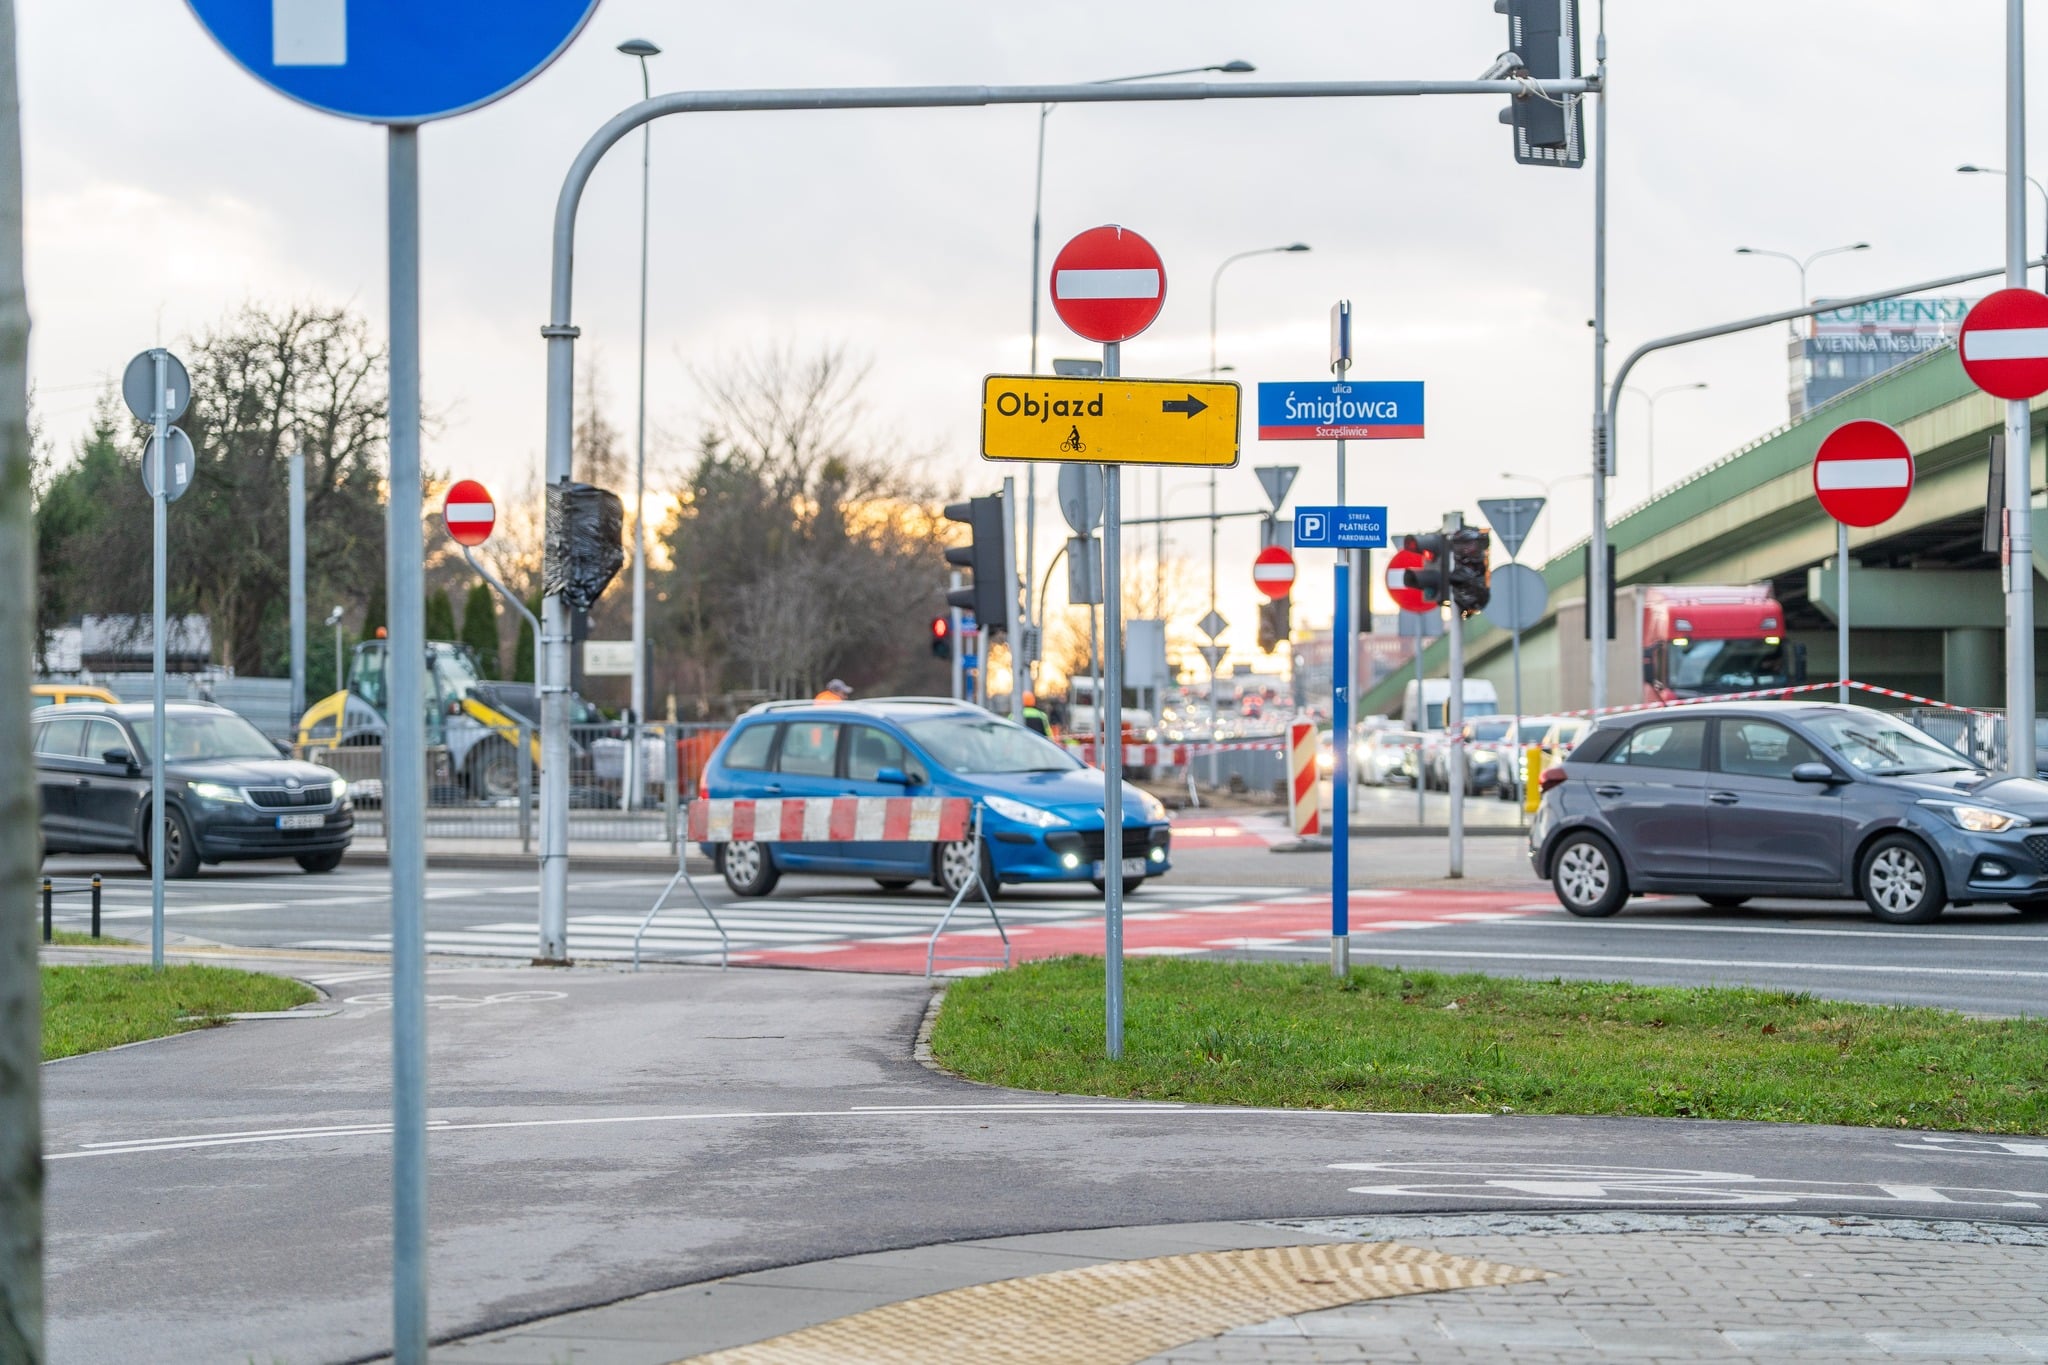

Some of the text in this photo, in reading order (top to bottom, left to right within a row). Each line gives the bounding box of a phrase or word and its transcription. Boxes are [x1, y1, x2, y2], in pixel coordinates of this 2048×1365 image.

[1815, 335, 1879, 352] VIENNA
[1332, 383, 1353, 394] ulica
[997, 391, 1104, 423] Objazd
[1286, 390, 1399, 425] Śmigłowca
[1315, 427, 1368, 438] Szczęśliwice
[1348, 513, 1370, 521] STREFA
[1305, 517, 1320, 537] P
[1339, 522, 1380, 532] PŁATNEGO
[1337, 534, 1381, 542] PARKOWANIA
